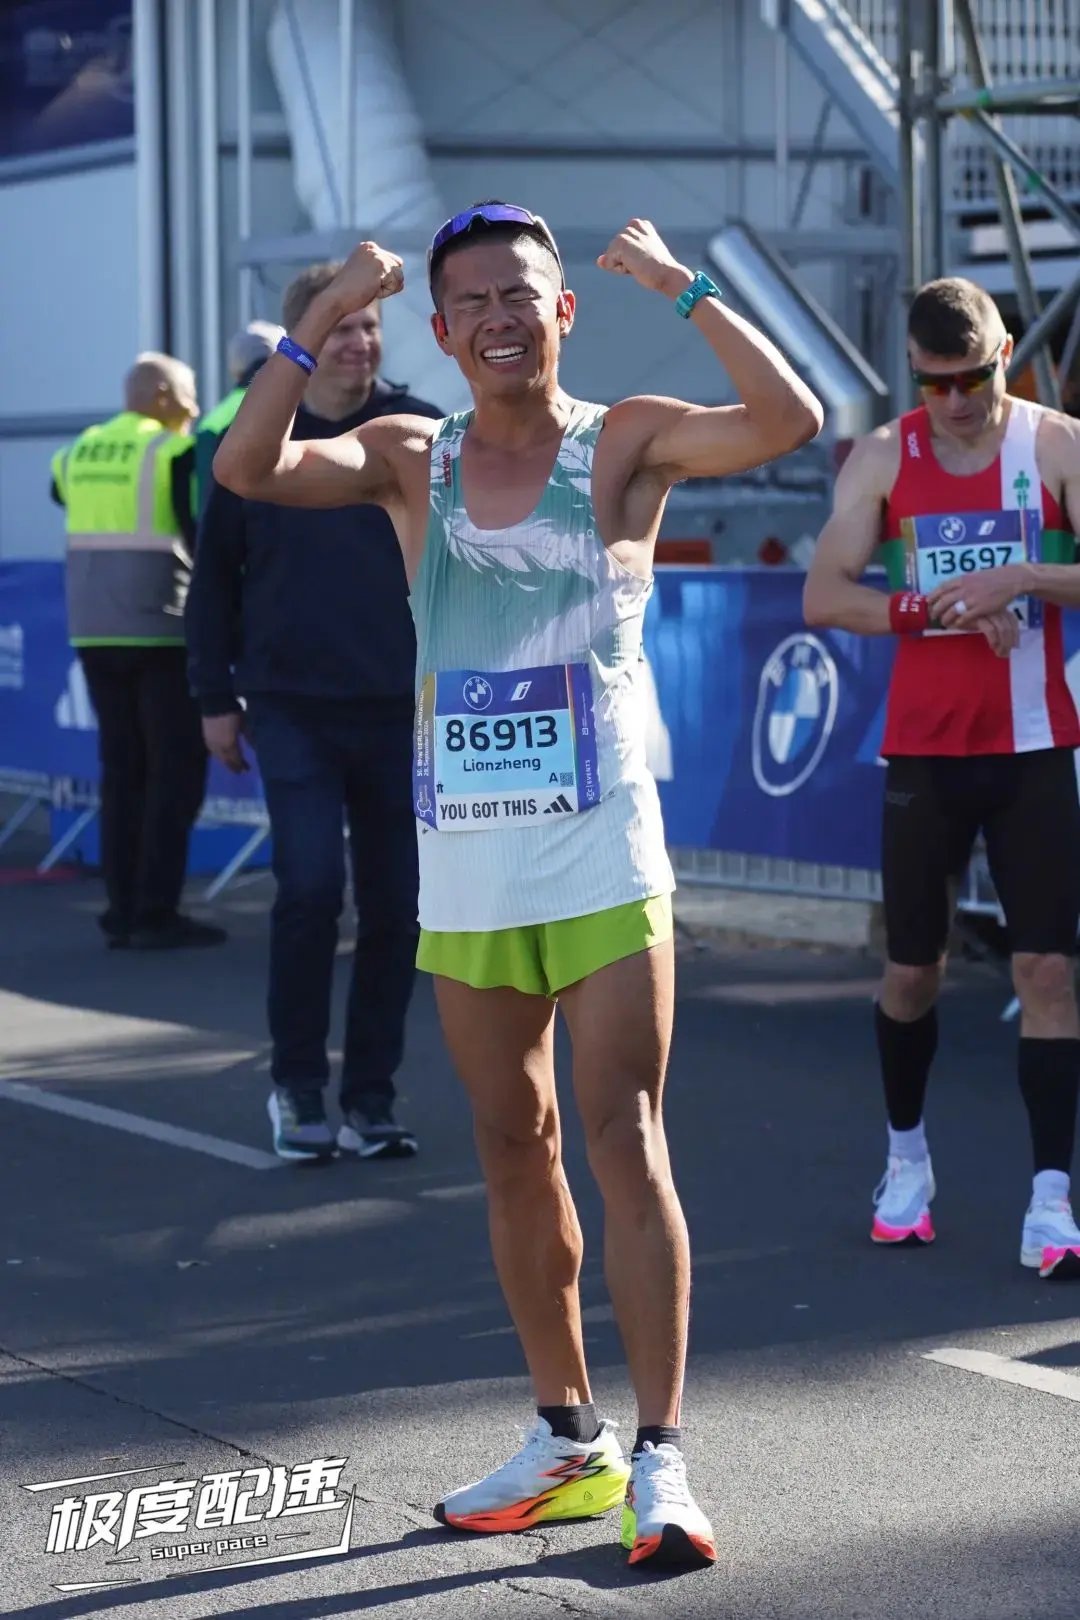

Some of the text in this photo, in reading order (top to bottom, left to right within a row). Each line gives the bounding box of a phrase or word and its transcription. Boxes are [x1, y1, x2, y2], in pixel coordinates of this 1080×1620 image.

[926, 546, 1013, 576] 13697
[445, 715, 558, 753] 86913
[463, 757, 541, 772] Lianzheng
[549, 774, 558, 784] A
[440, 799, 537, 820] YOU GOT THIS
